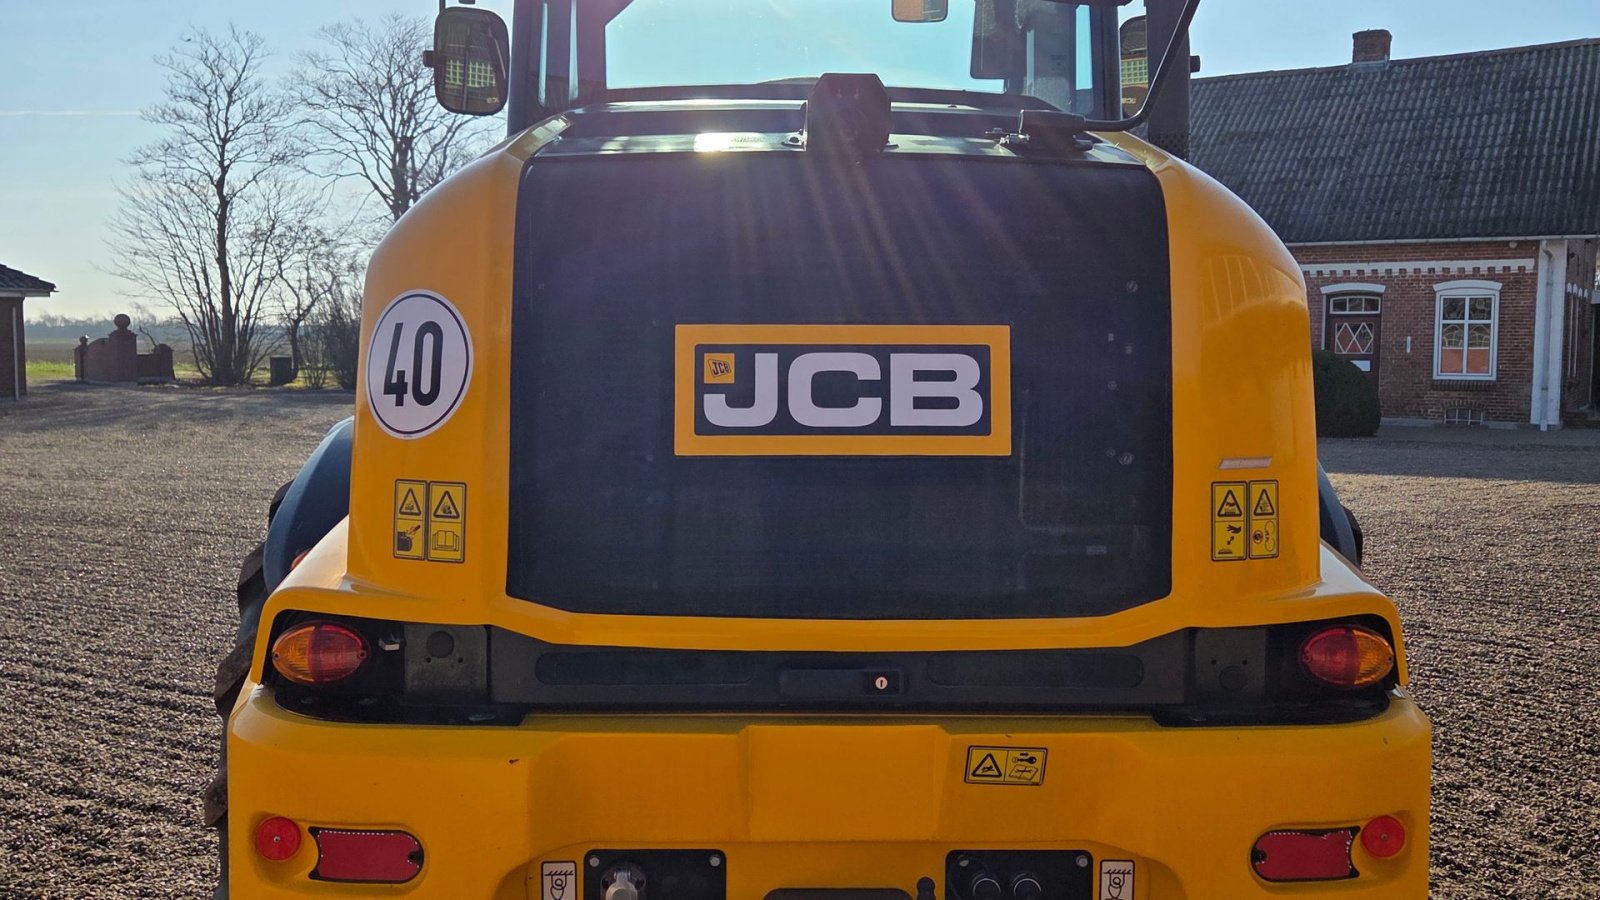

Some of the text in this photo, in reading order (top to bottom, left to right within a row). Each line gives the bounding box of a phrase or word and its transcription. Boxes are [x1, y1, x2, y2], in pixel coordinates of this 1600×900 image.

[383, 321, 444, 407] 40
[703, 352, 984, 427] JCB
[712, 361, 730, 376] JCB
